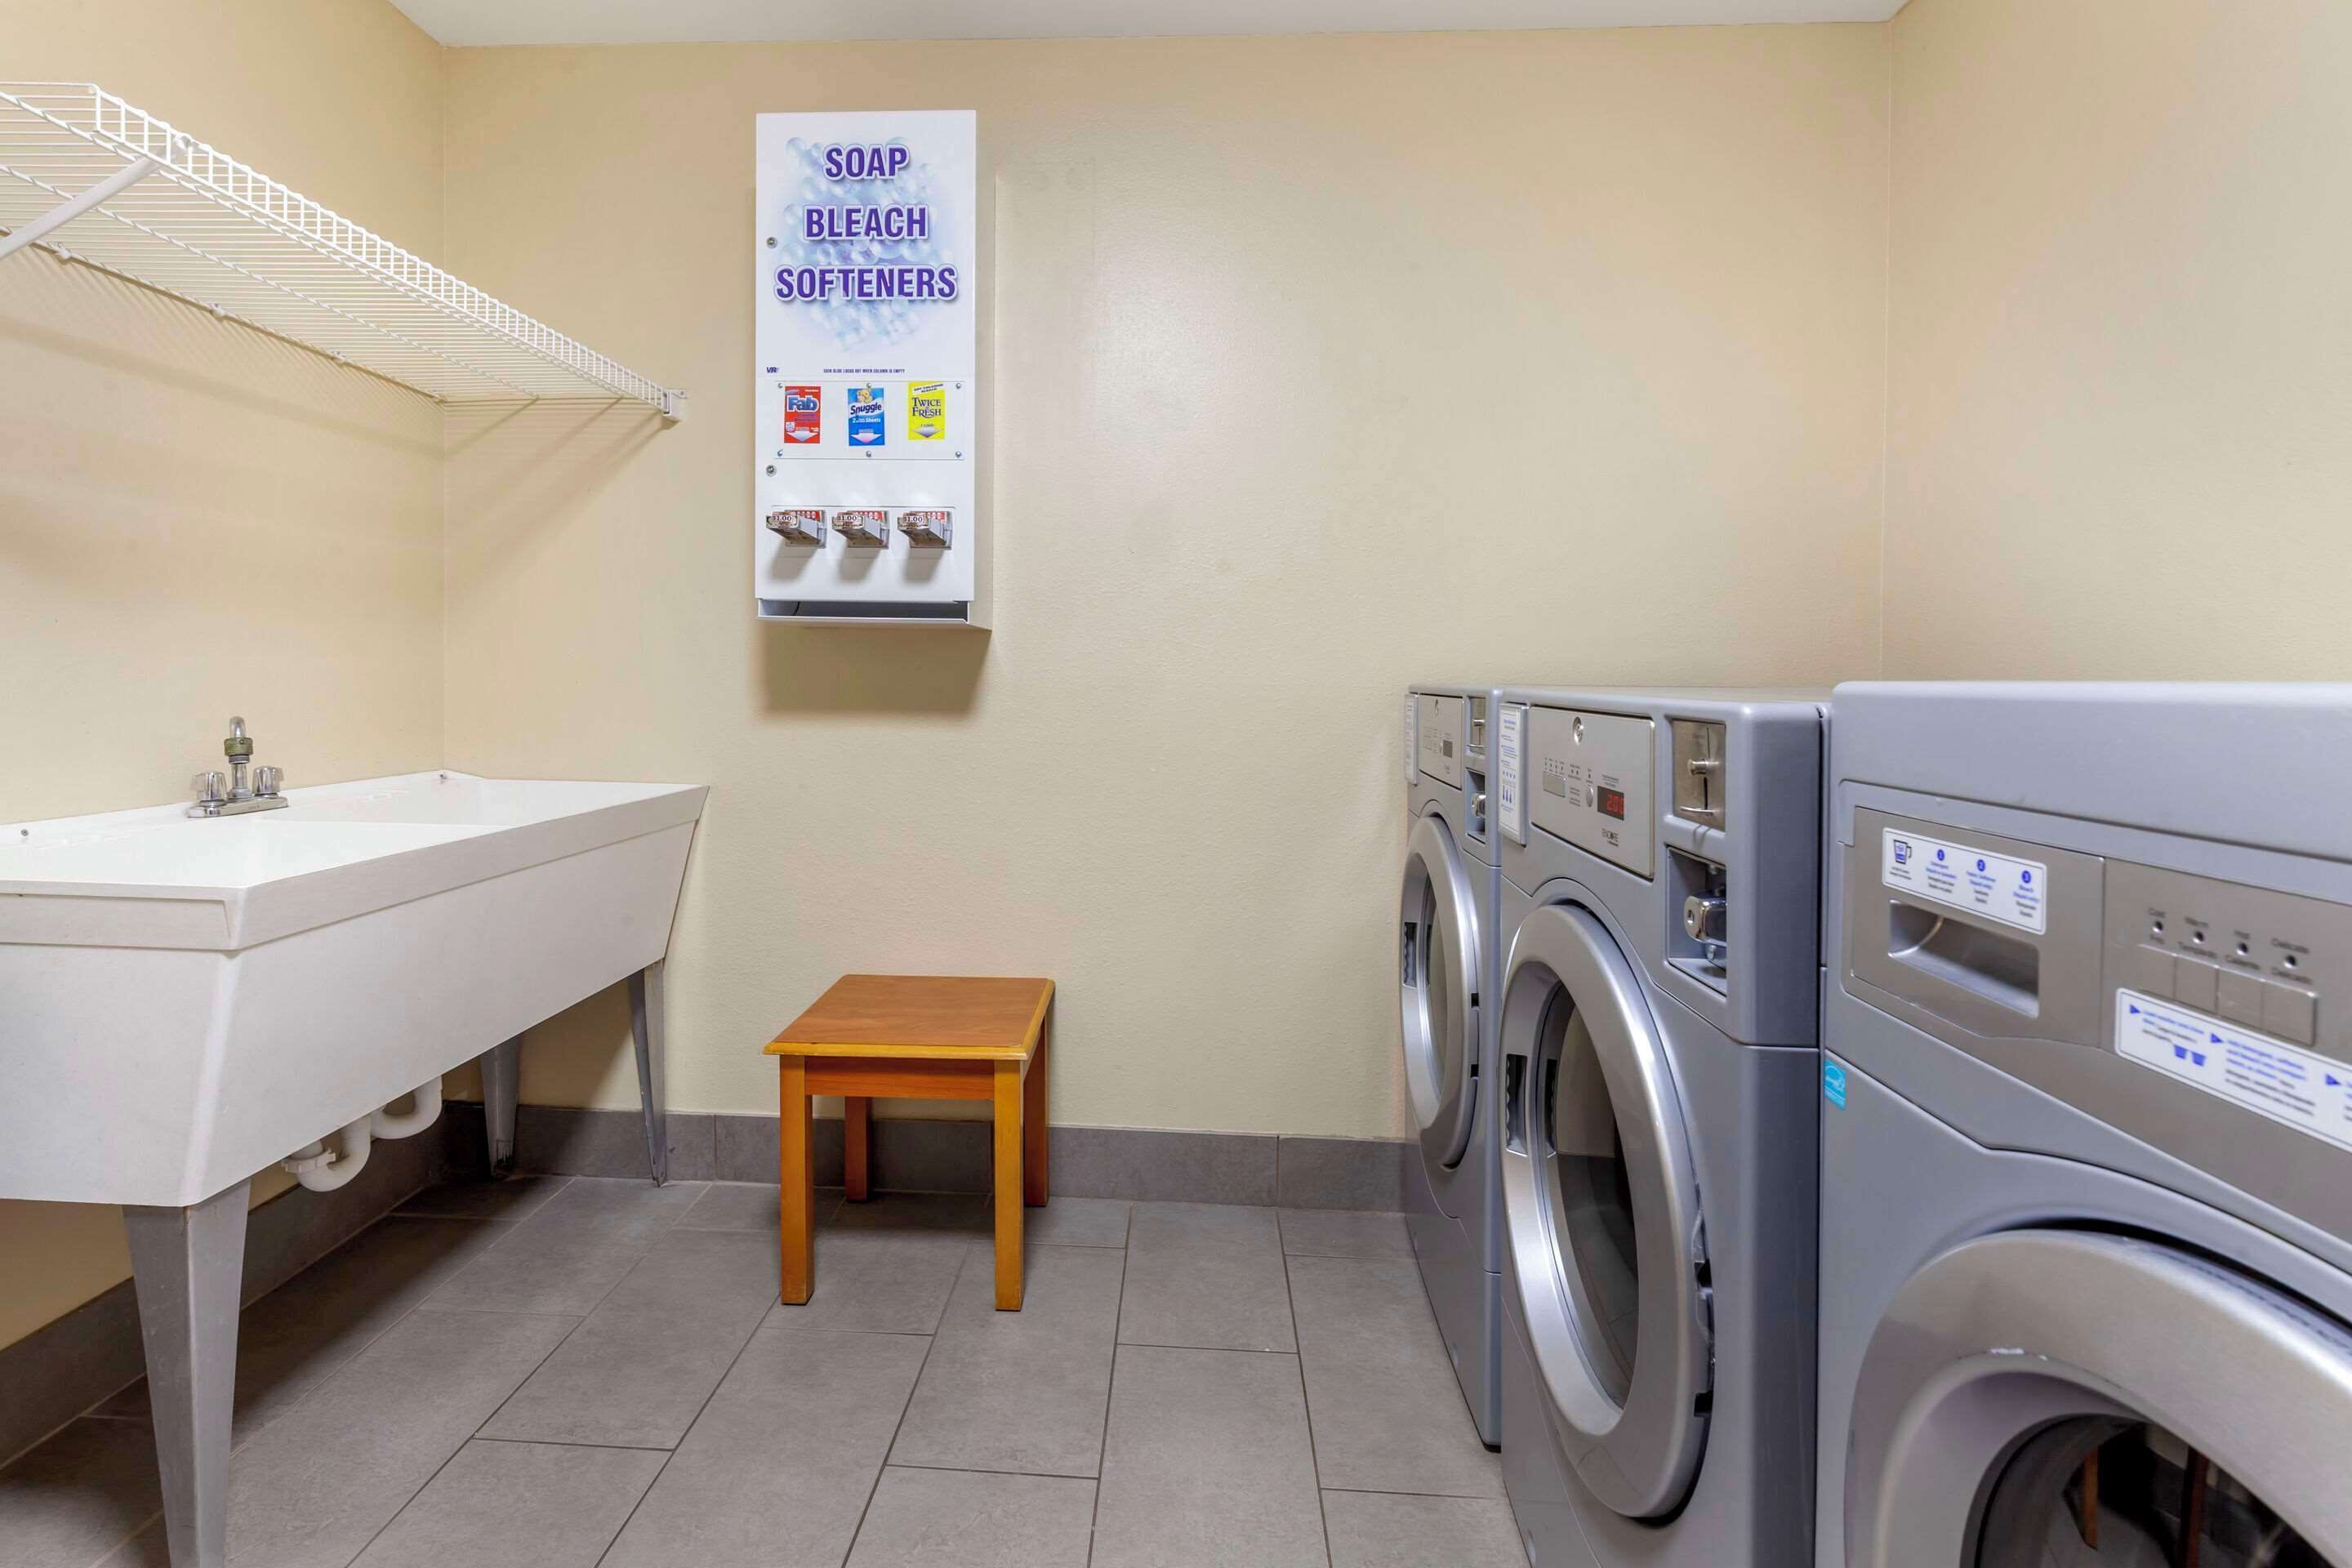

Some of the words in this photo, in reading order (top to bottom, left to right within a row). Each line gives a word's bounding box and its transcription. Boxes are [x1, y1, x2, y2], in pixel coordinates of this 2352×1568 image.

[825, 146, 908, 178] SOAP
[805, 207, 927, 238] BLEACH
[776, 267, 956, 299] SOFTENERS
[787, 395, 818, 412] Fab
[850, 403, 882, 415] Snuggle
[911, 397, 941, 407] TWICE
[912, 407, 942, 418] FRESH
